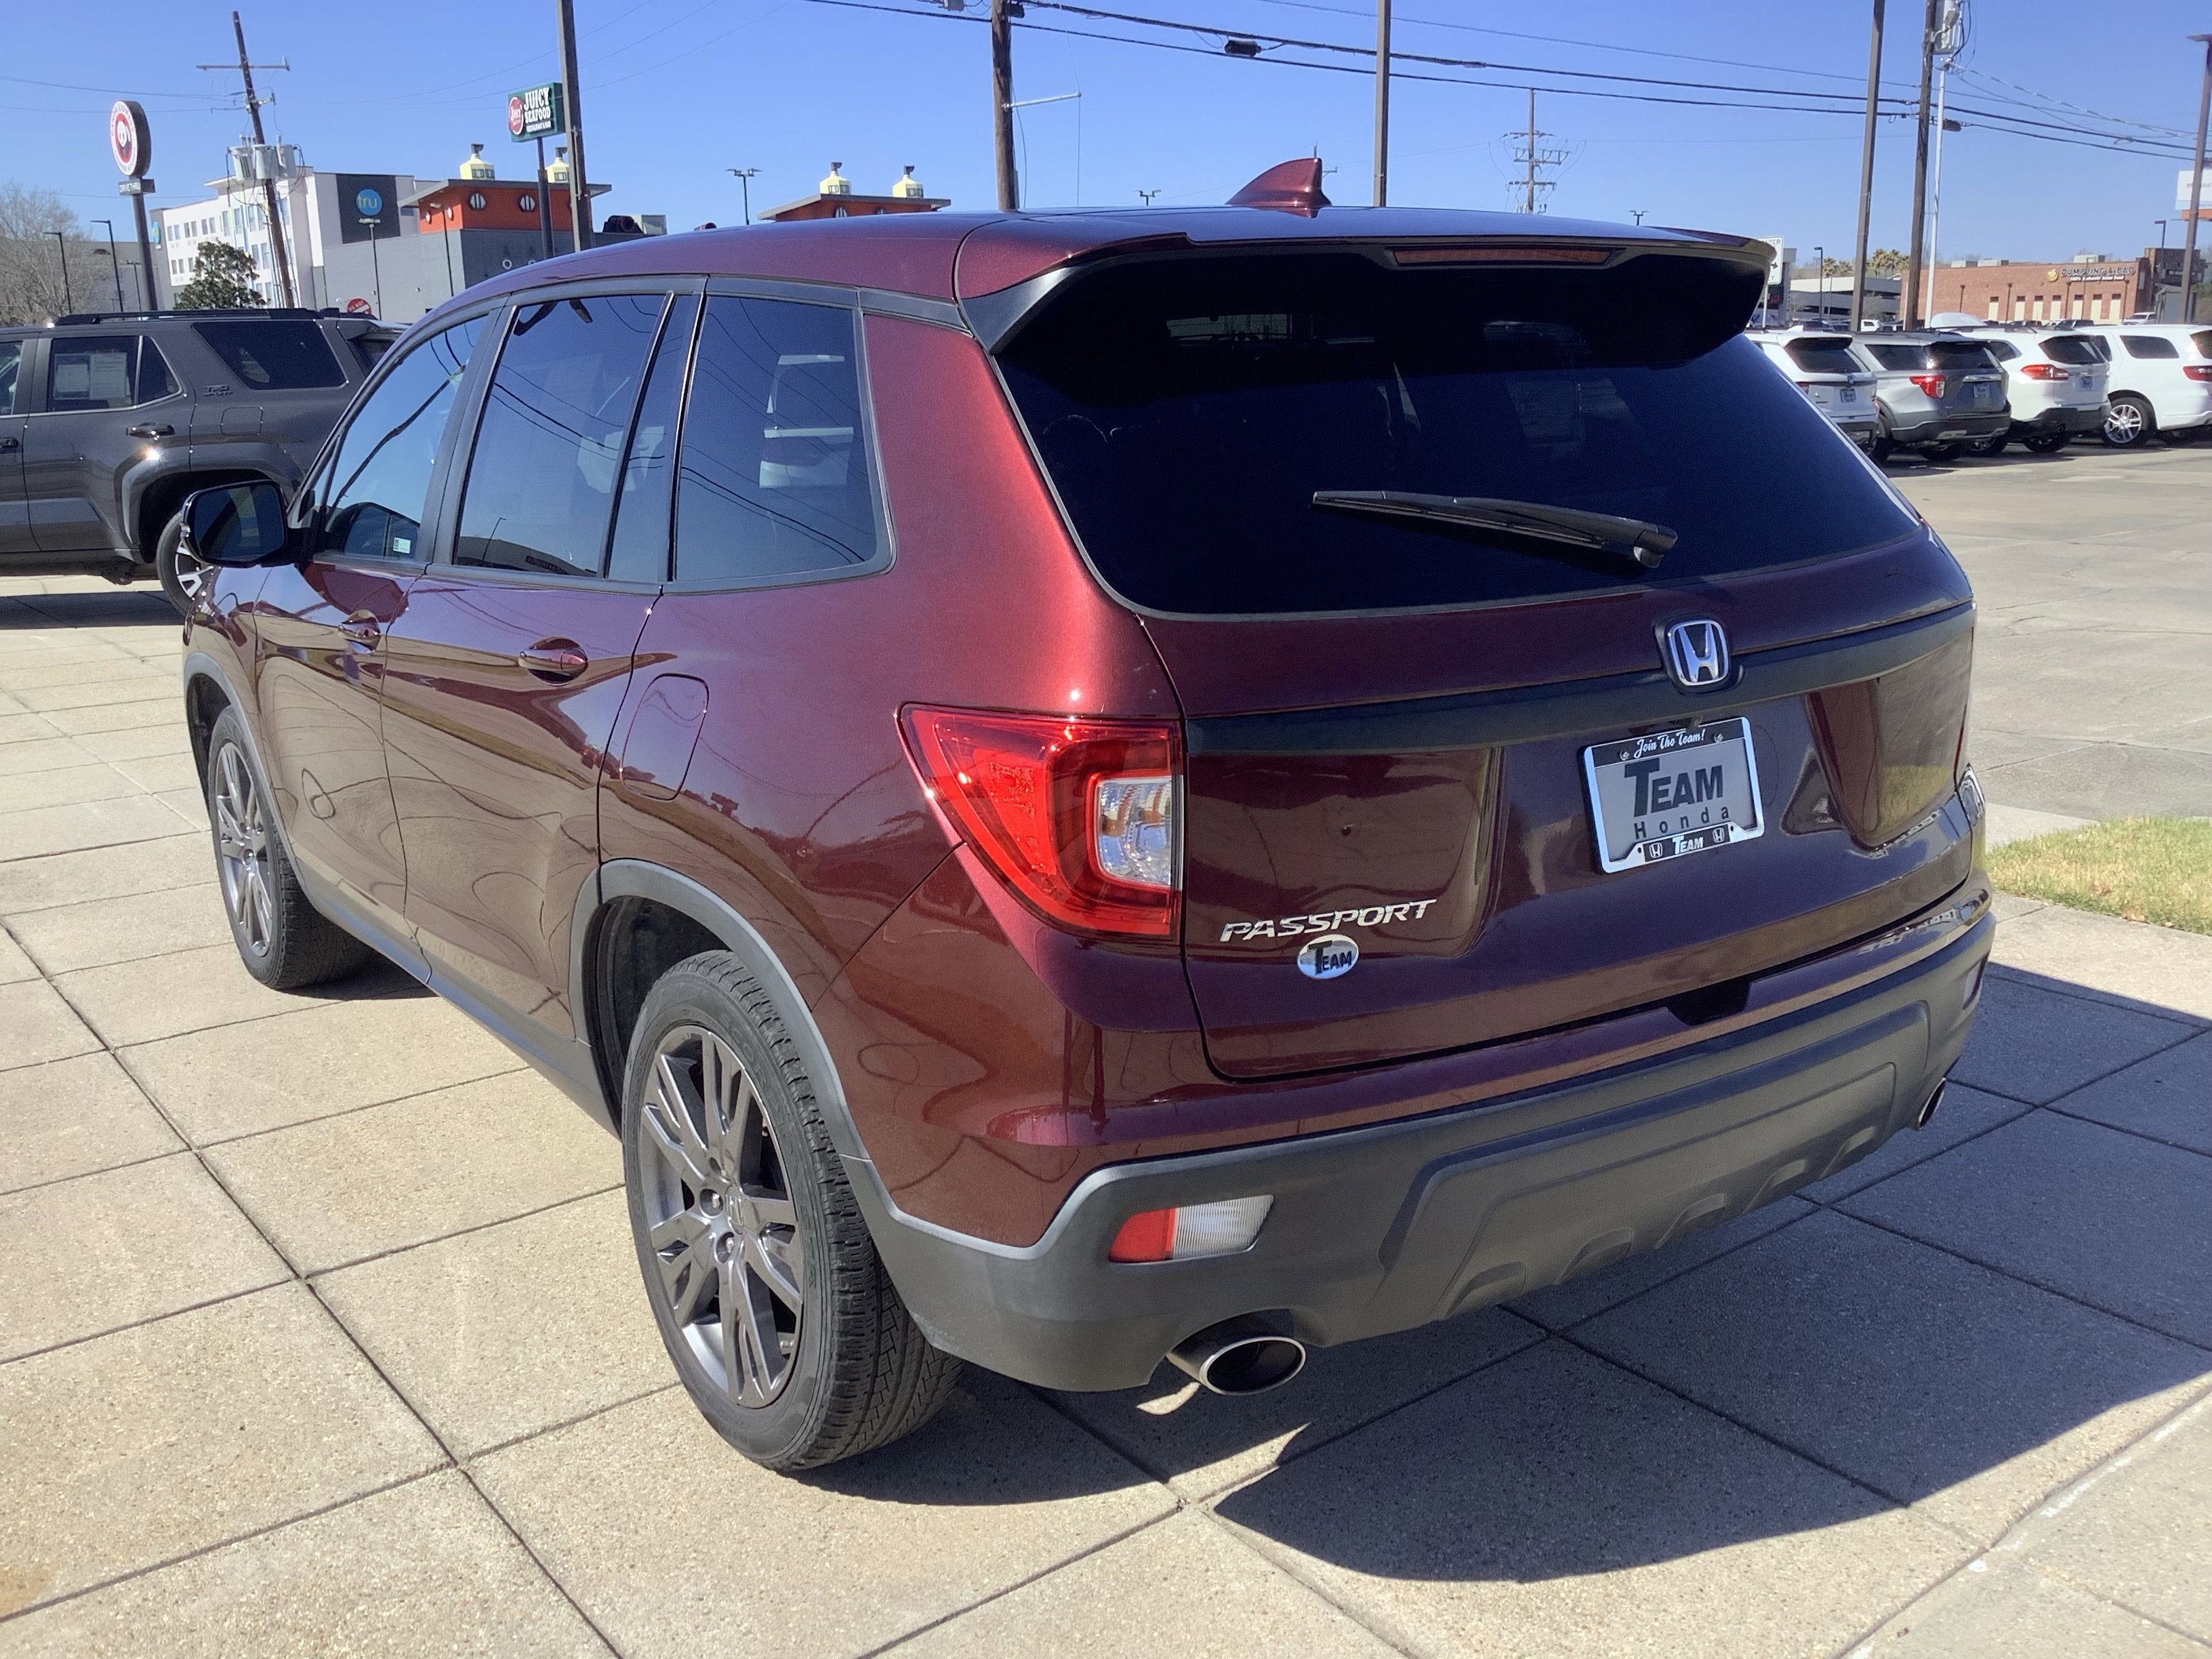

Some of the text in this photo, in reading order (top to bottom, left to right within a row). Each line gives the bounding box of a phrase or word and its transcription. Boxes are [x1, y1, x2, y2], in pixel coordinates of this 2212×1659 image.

[524, 87, 550, 111] JUICY
[525, 106, 551, 123] SEAFOOD
[357, 194, 377, 209] tru
[1633, 729, 1706, 759] Join The Team!
[1624, 758, 1724, 817] TEAM
[1633, 804, 1730, 840] Honda
[1673, 835, 1704, 855] TEAM
[1219, 899, 1437, 942] PASSPORT
[1307, 940, 1353, 975] TEAM
